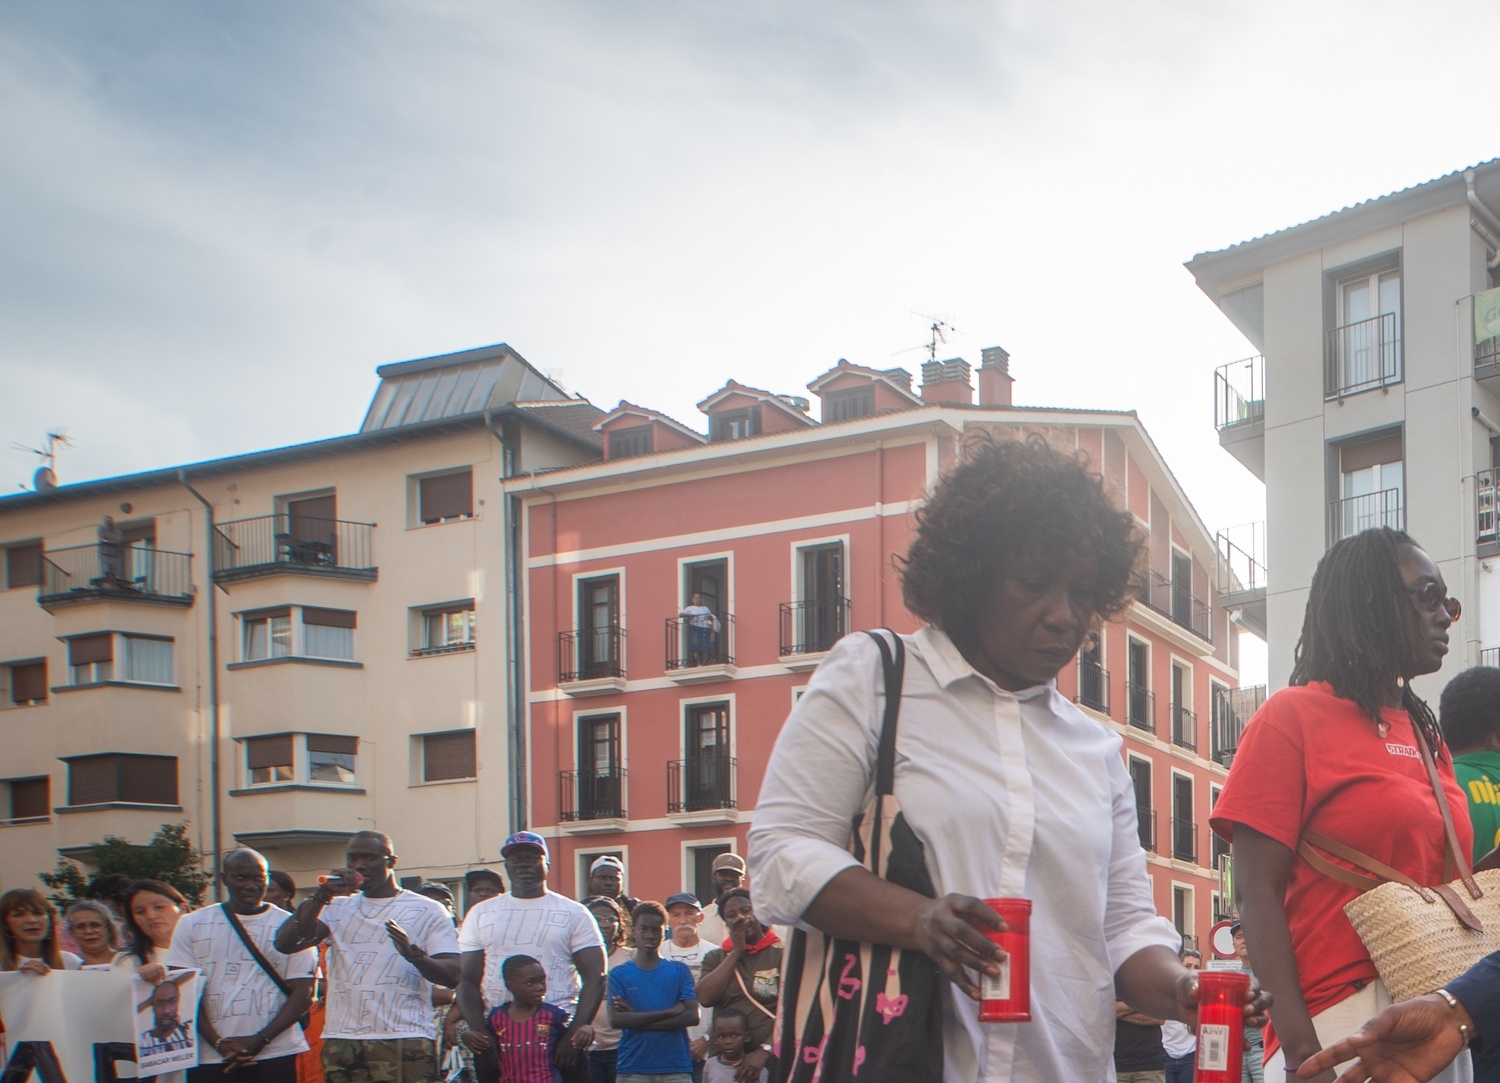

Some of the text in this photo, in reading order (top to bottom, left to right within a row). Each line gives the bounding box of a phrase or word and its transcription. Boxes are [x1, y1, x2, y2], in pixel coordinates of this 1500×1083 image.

[477, 908, 572, 947] STOP
[140, 1052, 195, 1069] BABACAR WELER
